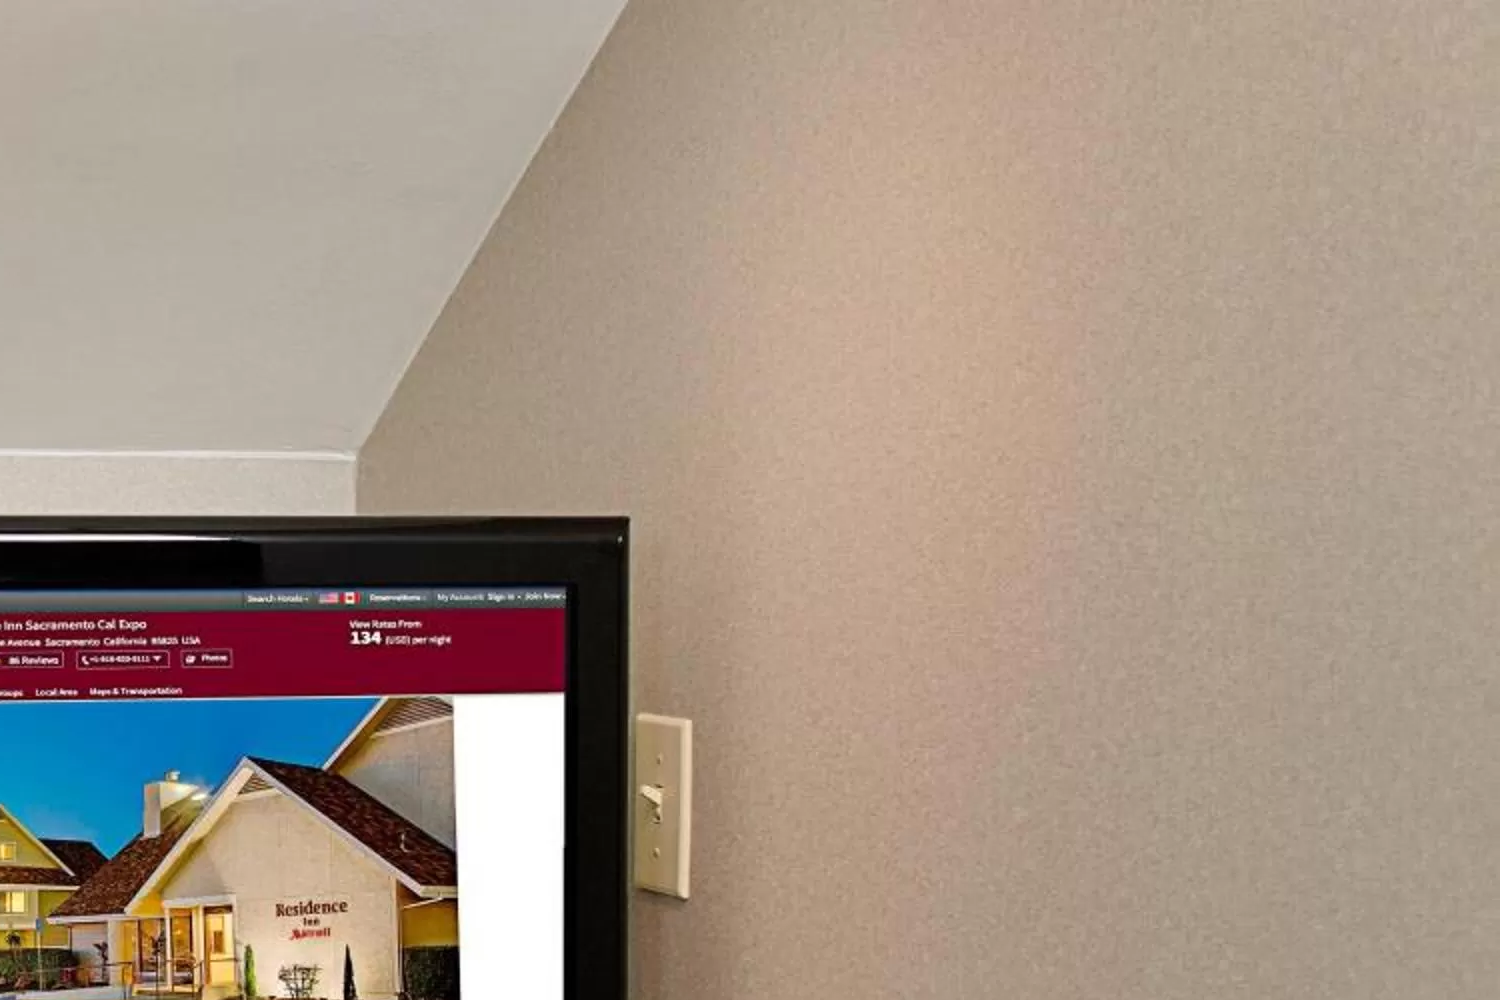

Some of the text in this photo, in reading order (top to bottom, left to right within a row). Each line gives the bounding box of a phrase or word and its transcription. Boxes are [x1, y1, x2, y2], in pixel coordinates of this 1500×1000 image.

[4, 621, 23, 630] Inn
[25, 620, 95, 631] Sacramento
[98, 619, 117, 629] Cal
[119, 619, 147, 631] Expo
[350, 631, 382, 645] 134
[275, 899, 348, 917] Residence
